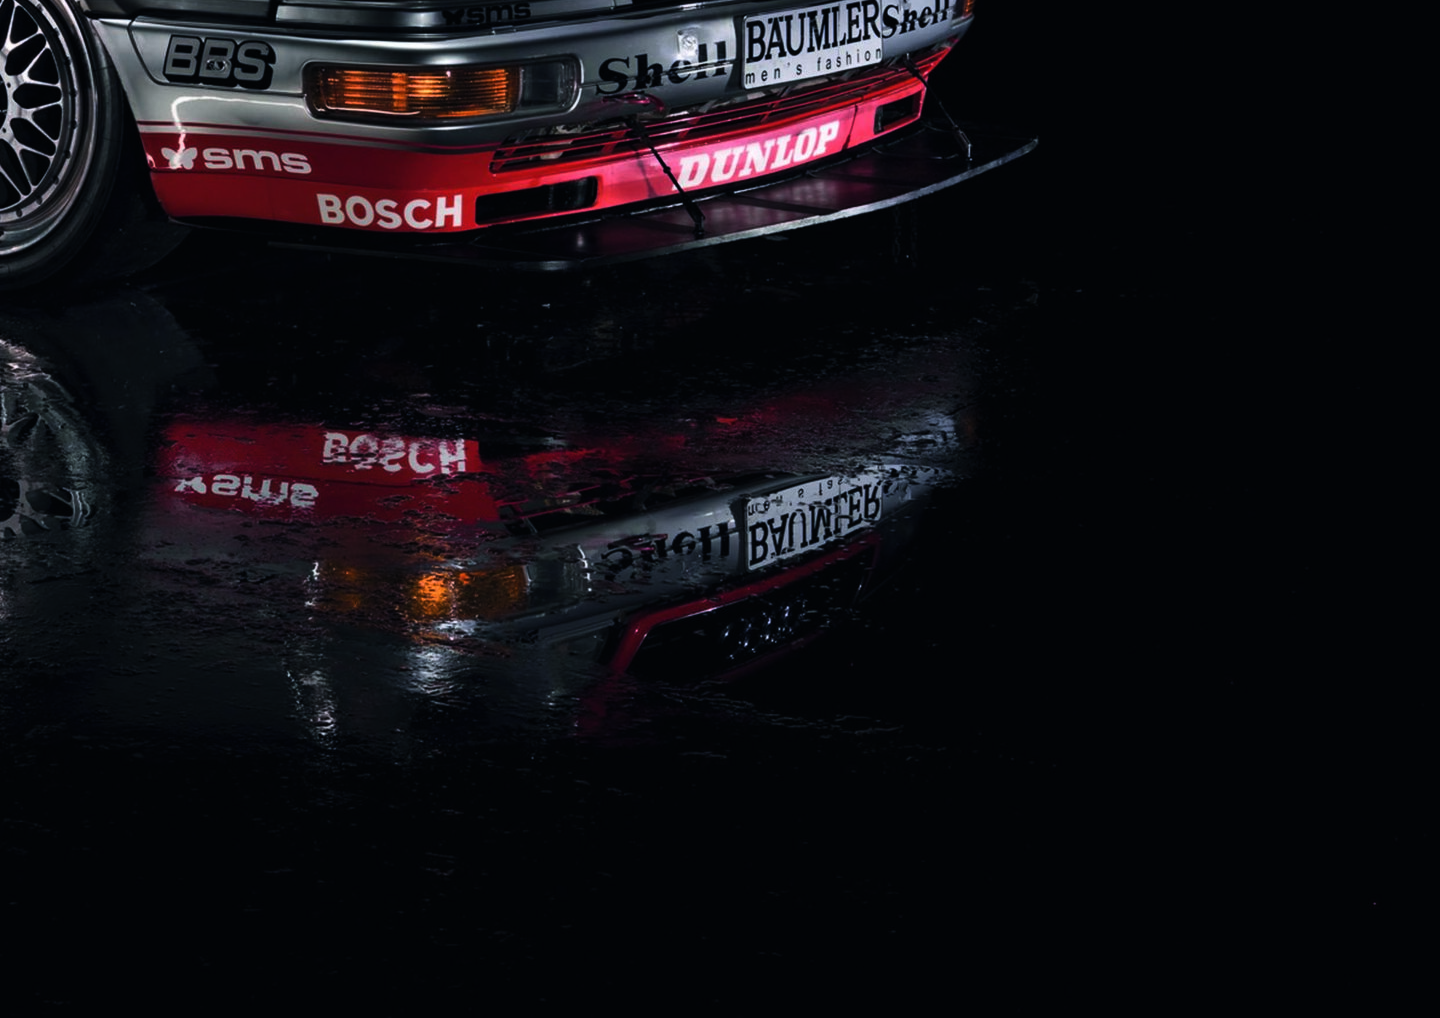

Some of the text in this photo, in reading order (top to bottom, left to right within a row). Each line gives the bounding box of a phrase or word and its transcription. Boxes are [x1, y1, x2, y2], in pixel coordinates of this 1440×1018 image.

[467, 2, 531, 24] sms
[163, 34, 276, 89] BBS
[595, 40, 728, 96] Shell
[745, 47, 882, 85] men's fashion
[202, 146, 313, 175] sms
[672, 120, 840, 192] DUNLOP
[316, 193, 463, 230] BOSCH
